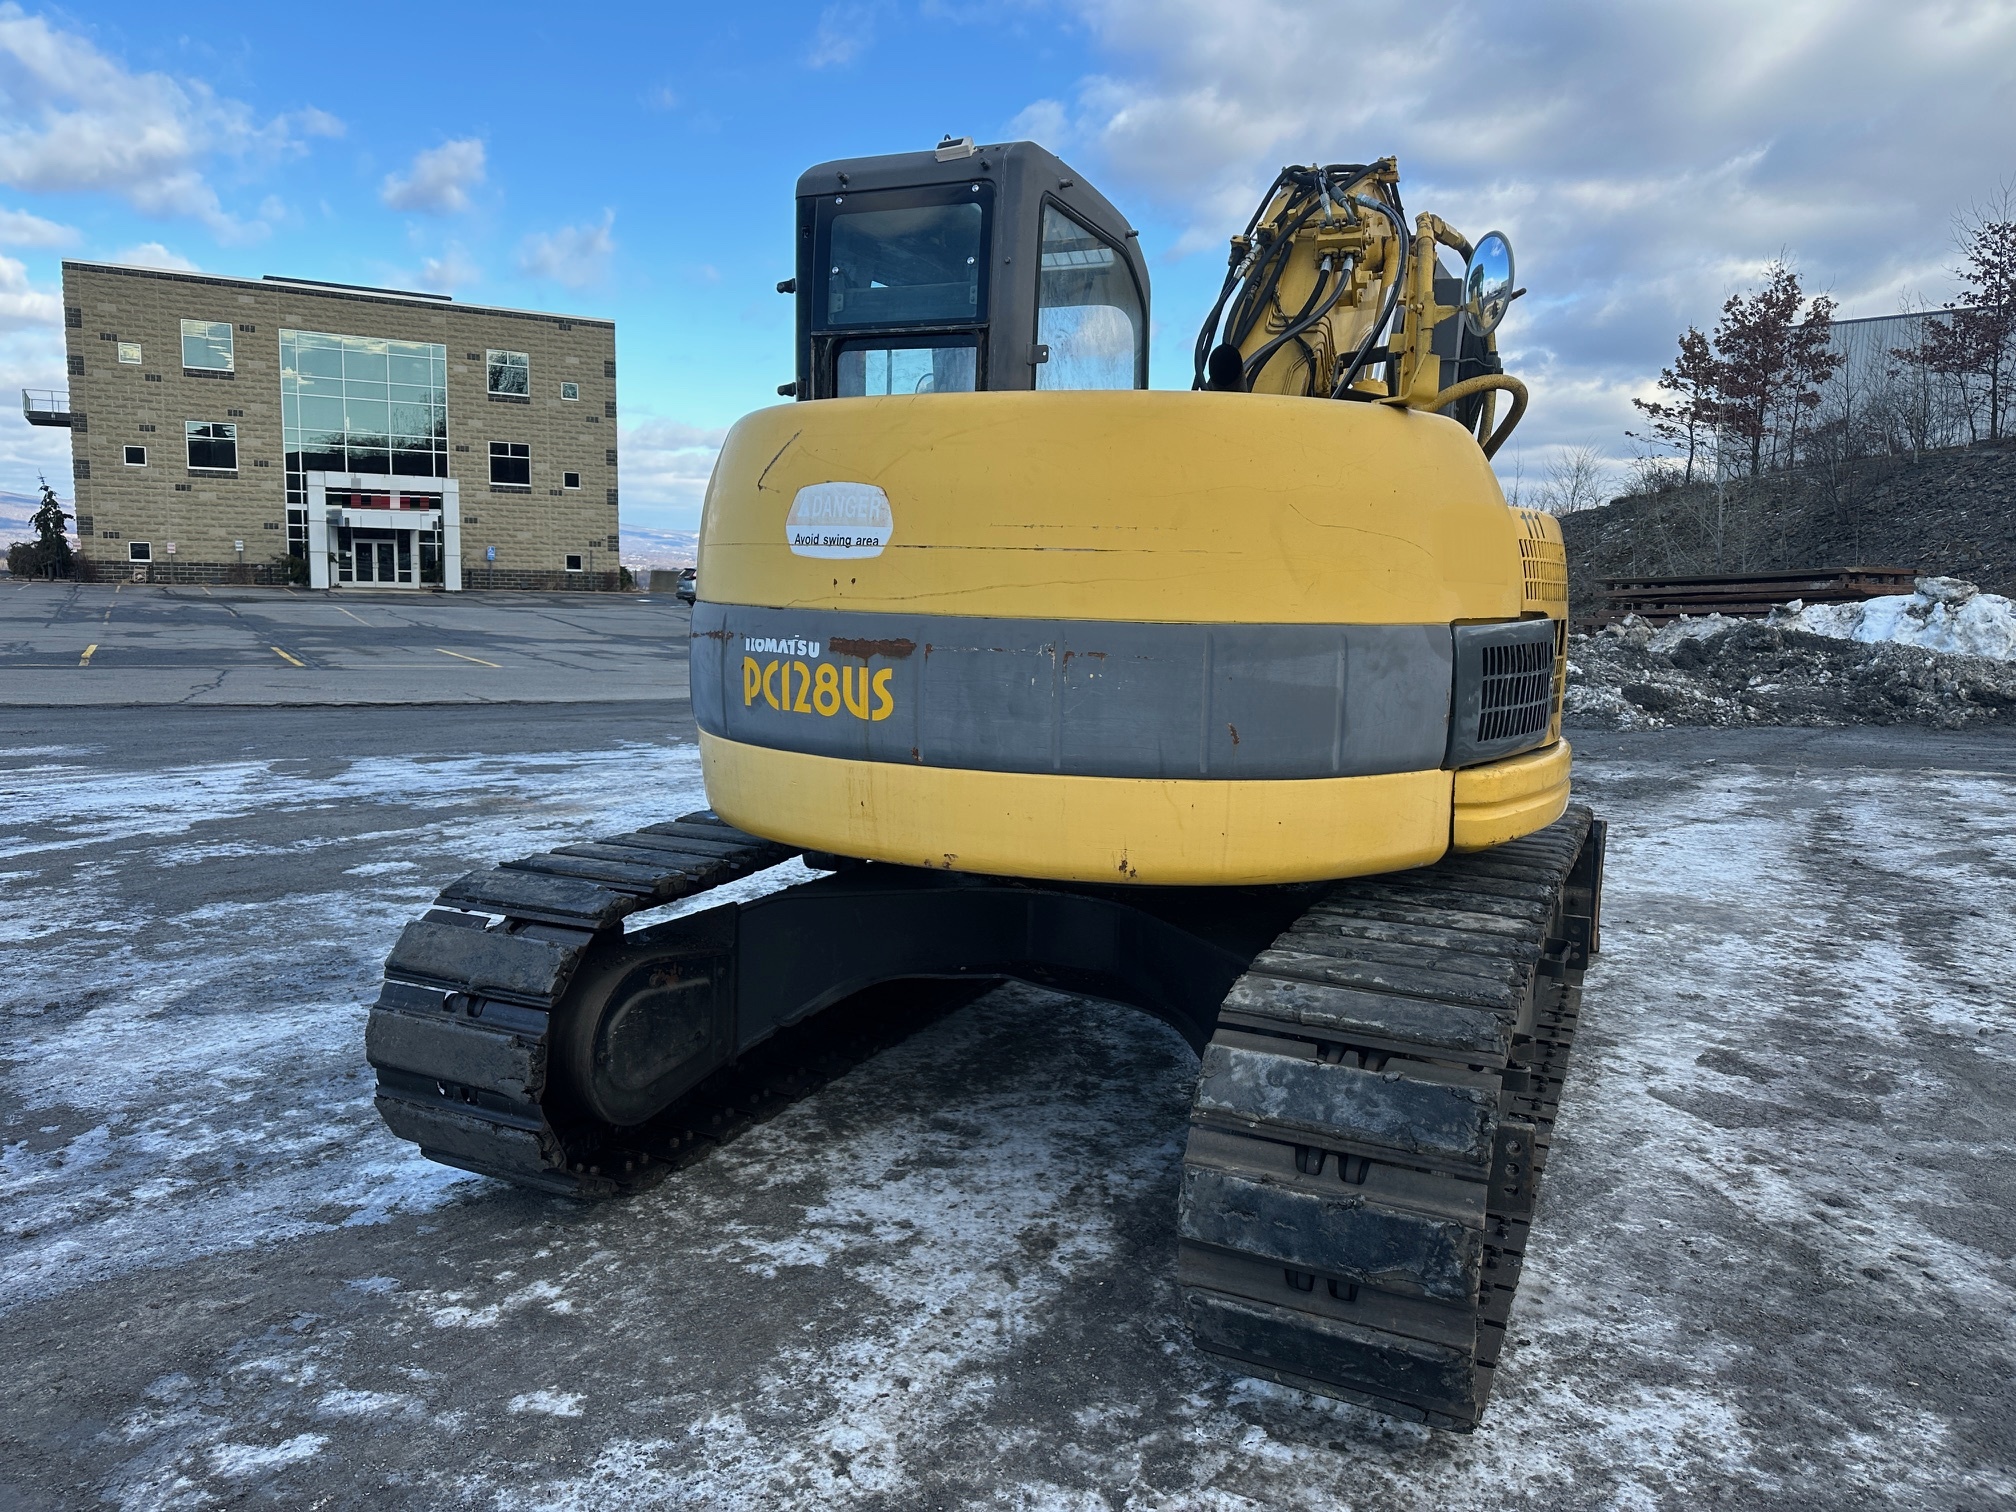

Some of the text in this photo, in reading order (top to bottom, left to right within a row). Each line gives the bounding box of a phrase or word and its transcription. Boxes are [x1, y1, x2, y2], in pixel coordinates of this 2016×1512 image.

[811, 495, 881, 518] DANGER
[794, 533, 880, 548] Avoid swing area
[745, 634, 820, 658] KOMATSU
[743, 656, 894, 721] PC128US
